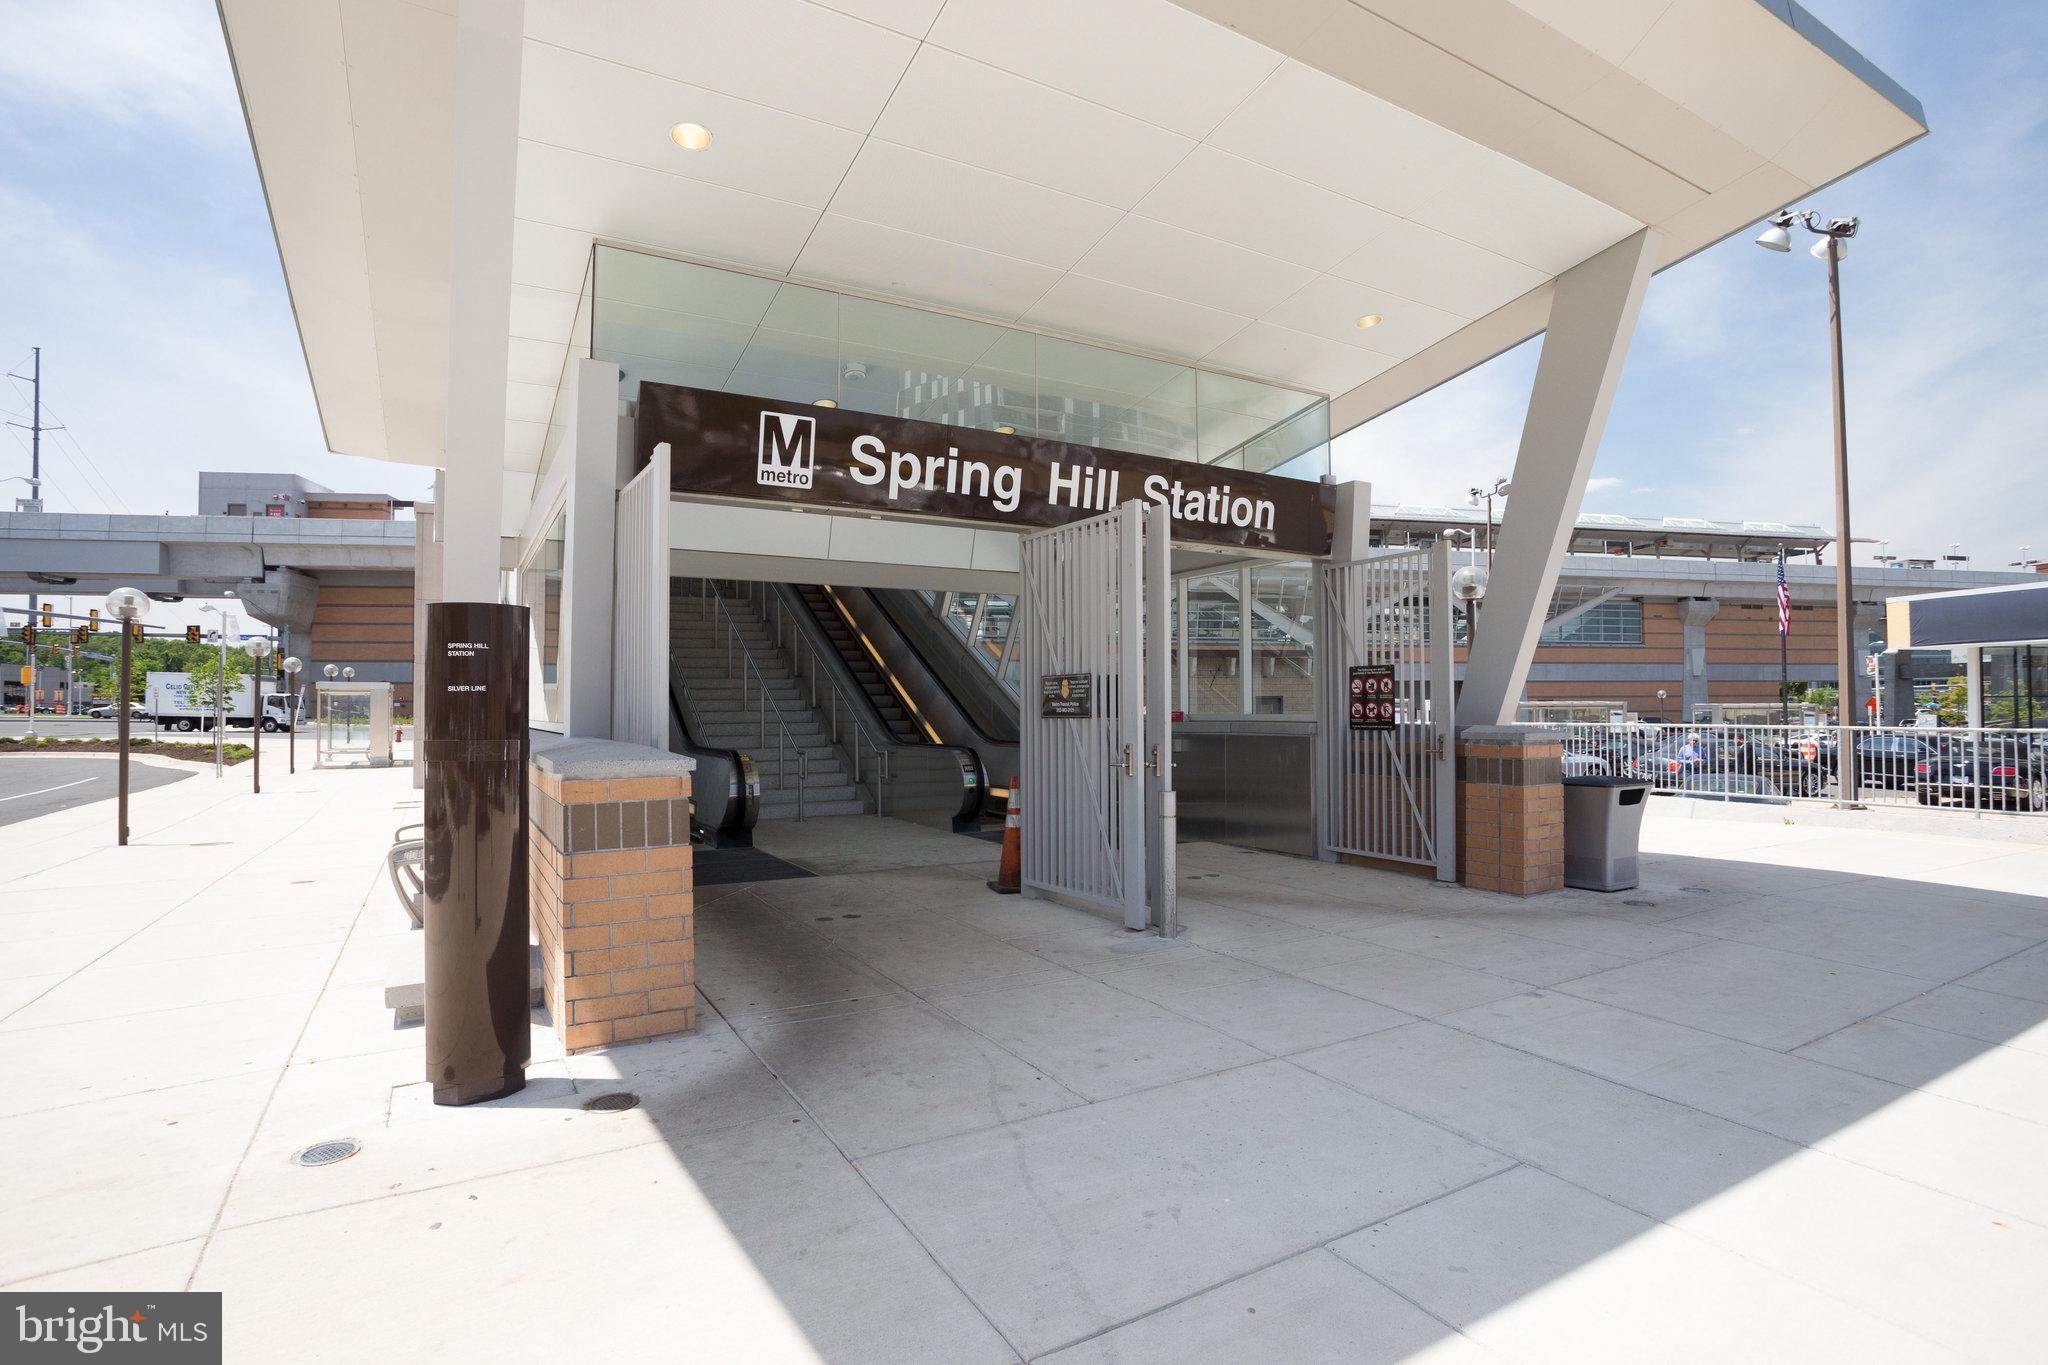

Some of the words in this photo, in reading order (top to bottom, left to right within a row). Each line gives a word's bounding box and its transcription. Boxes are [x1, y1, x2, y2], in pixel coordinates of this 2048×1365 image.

[762, 414, 812, 469] M
[761, 469, 809, 485] metro
[849, 435, 1023, 513] Spring
[1048, 461, 1119, 511] Hill
[1143, 474, 1275, 531] Station
